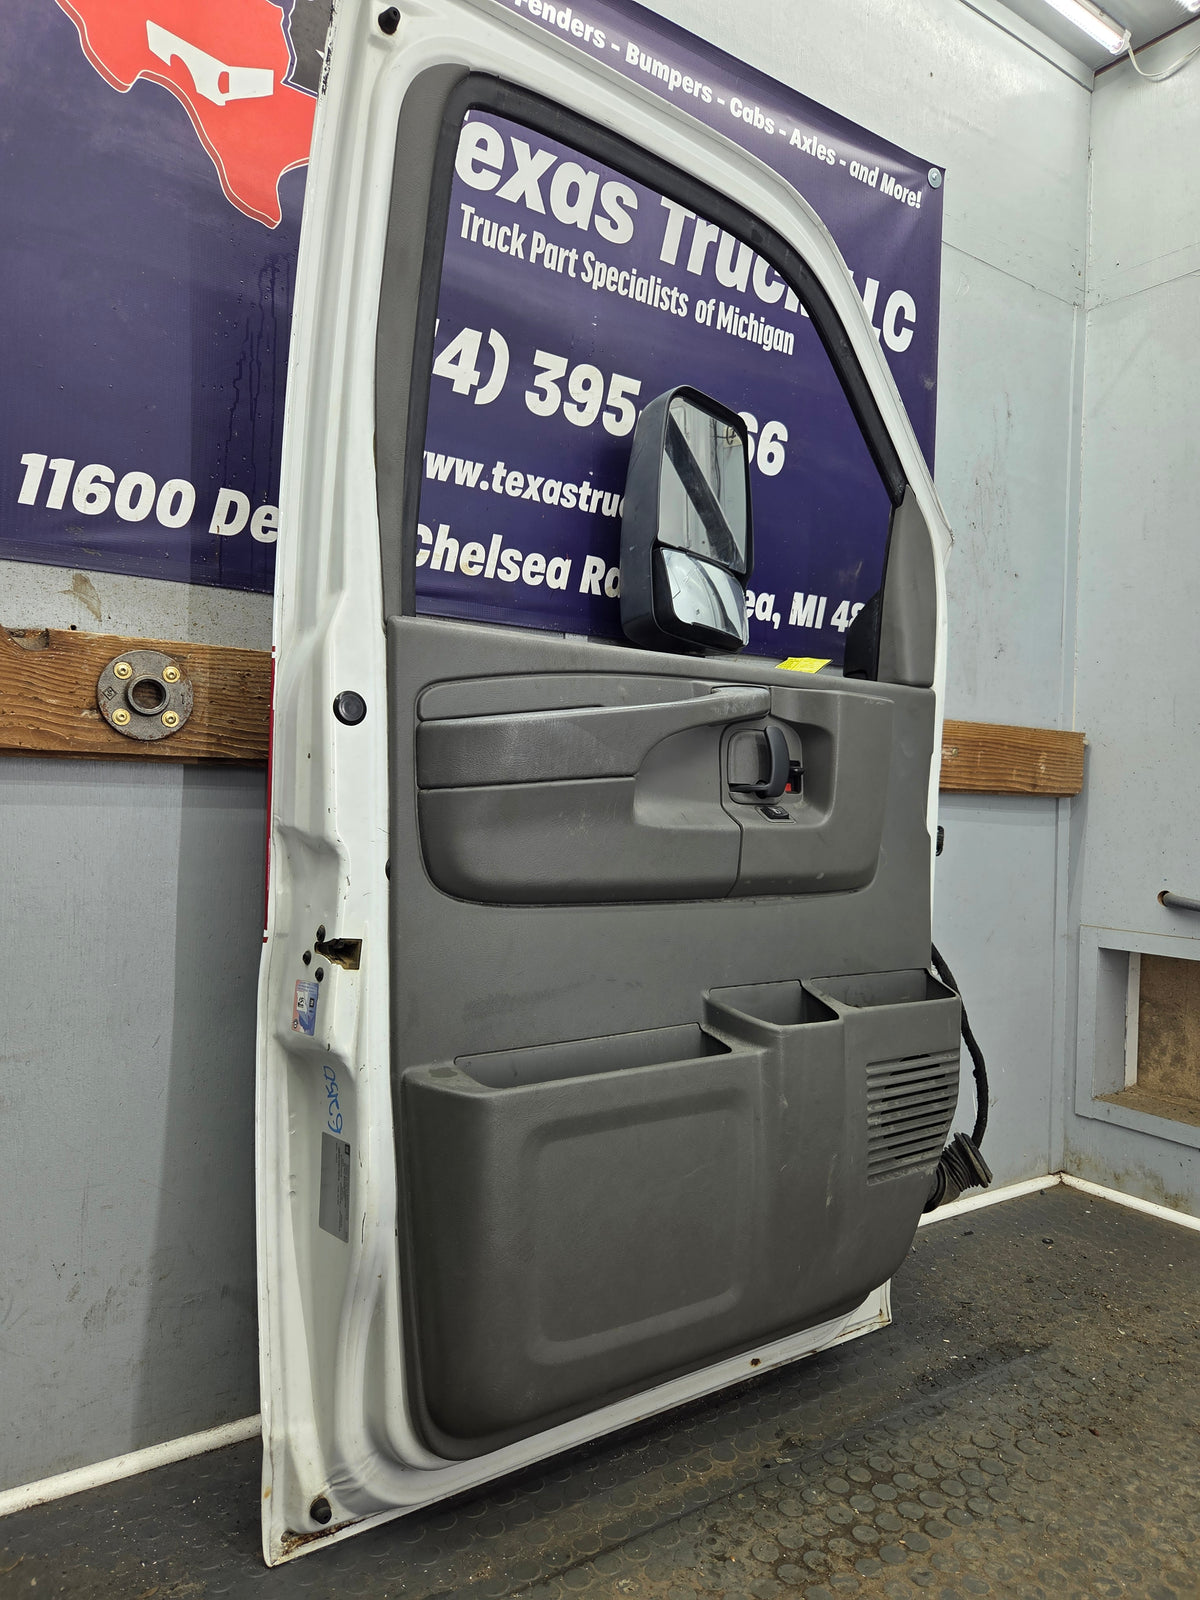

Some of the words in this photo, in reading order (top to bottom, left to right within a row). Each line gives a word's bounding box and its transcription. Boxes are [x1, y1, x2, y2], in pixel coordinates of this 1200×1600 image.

[454, 109, 639, 245] exas
[626, 41, 712, 103] Bumpers
[730, 96, 775, 135] Cabs
[789, 127, 836, 165] Axles
[849, 159, 879, 187] and
[879, 170, 923, 209] More!
[460, 203, 527, 260] Truck
[530, 230, 578, 278] Part
[581, 248, 690, 317] Specialists
[695, 298, 716, 325] of
[717, 303, 795, 356] Michigan
[18, 453, 195, 528] 11600
[788, 591, 828, 630] MI
